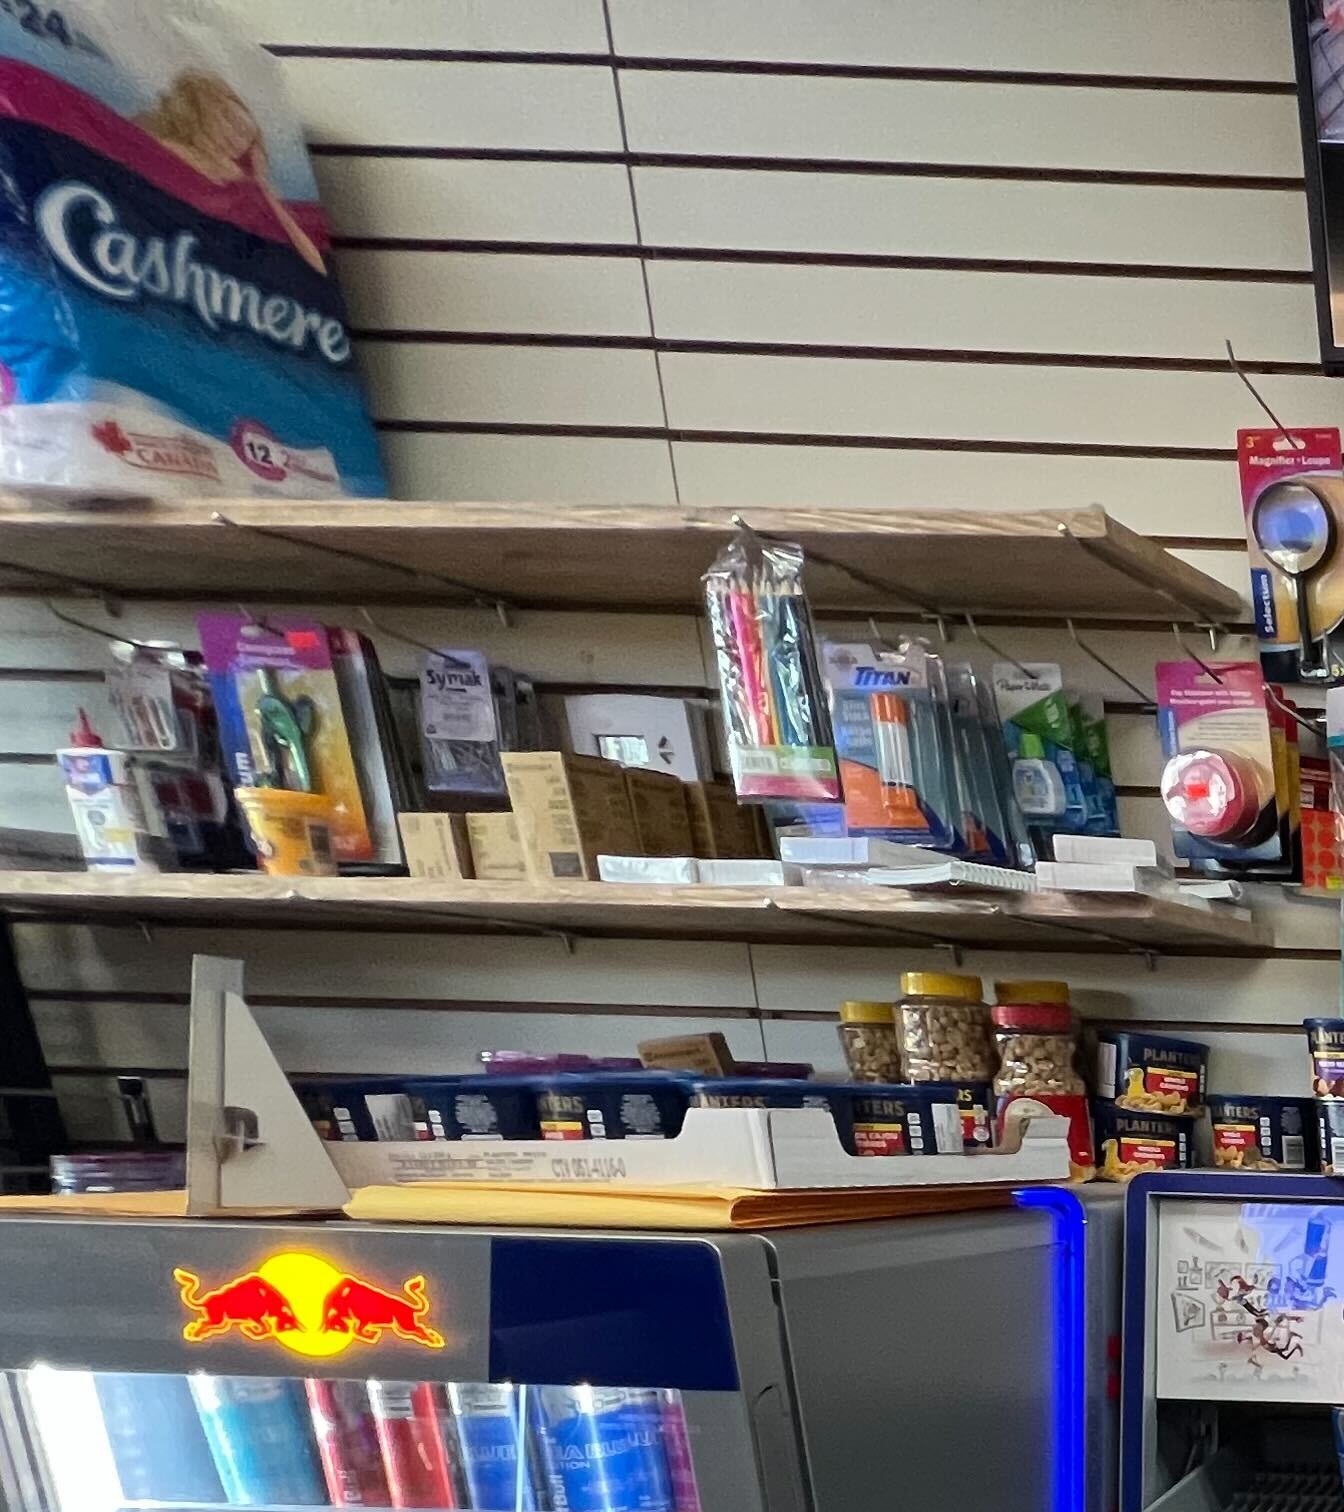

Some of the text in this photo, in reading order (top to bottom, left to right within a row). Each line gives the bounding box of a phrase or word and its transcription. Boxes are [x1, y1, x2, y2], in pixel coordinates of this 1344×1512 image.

[36, 183, 351, 364] Cashmere
[245, 439, 275, 465] 12
[1249, 455, 1296, 466] Magnifier
[1262, 573, 1275, 634] Selectum
[425, 669, 483, 692] Symak
